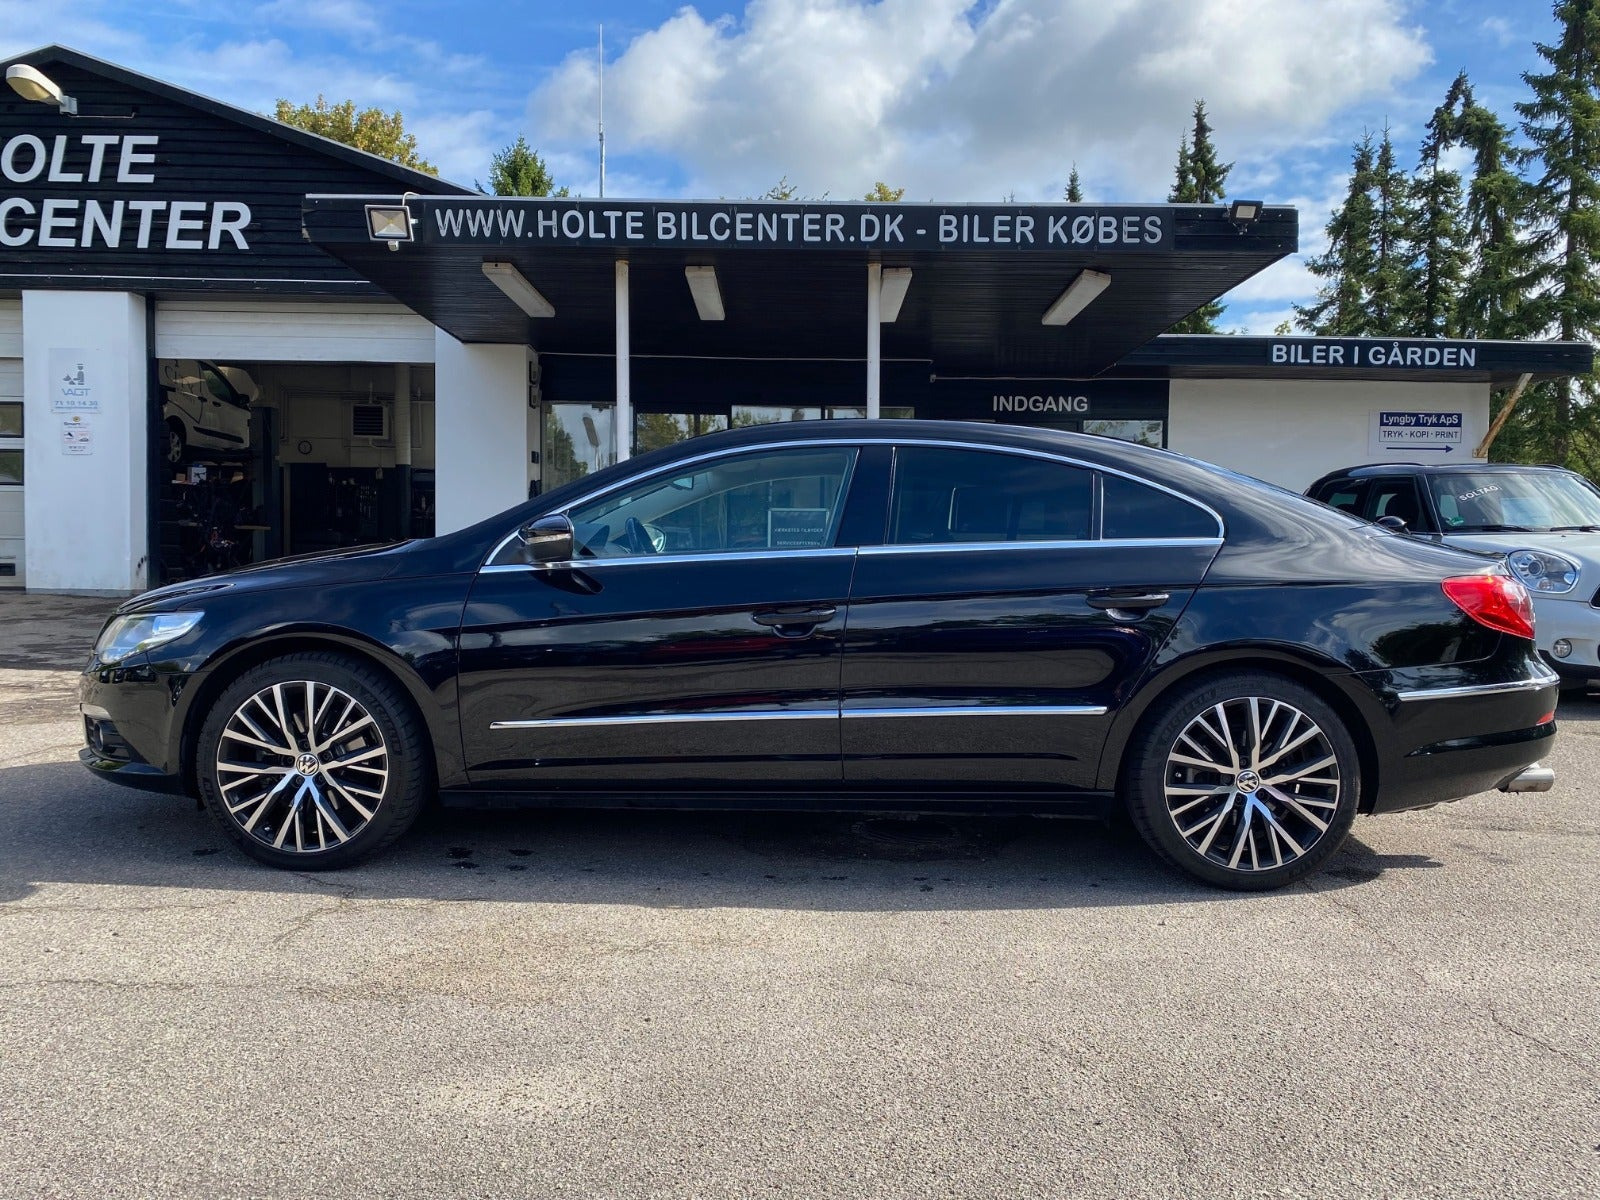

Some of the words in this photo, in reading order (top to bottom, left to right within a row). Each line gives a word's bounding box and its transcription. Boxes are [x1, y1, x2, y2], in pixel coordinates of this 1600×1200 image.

[0, 134, 159, 183] OLTE
[0, 197, 251, 250] CENTER
[434, 208, 645, 239] WWW.HOLTE
[657, 211, 905, 242] BILCENTER.DK
[938, 214, 1035, 243] BILER
[1048, 215, 1163, 244] KØBES
[1272, 344, 1345, 364] BILER
[1353, 346, 1359, 364] I
[1368, 341, 1476, 367] GÅRDEN
[993, 395, 1088, 412] INDGANG
[1383, 414, 1416, 426] Lyngby
[1418, 414, 1438, 426] Tryk
[1439, 414, 1459, 426] ApS
[1382, 430, 1404, 438] TRYK
[1409, 430, 1429, 438] KOPI
[1435, 431, 1459, 439] PRINT
